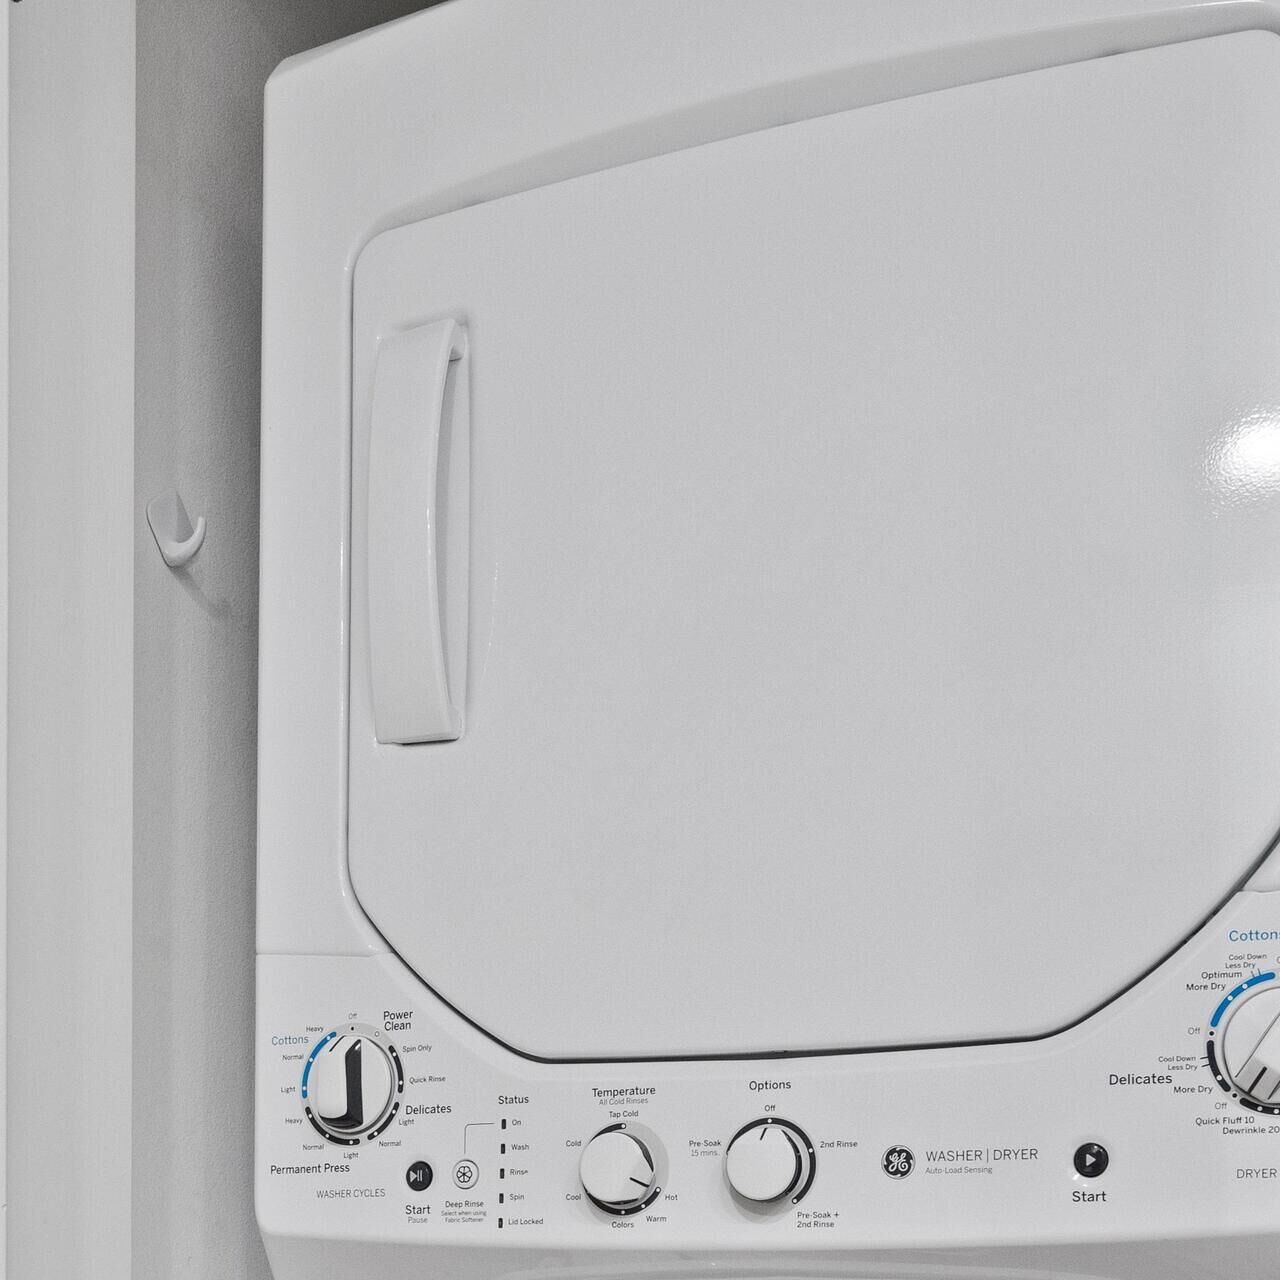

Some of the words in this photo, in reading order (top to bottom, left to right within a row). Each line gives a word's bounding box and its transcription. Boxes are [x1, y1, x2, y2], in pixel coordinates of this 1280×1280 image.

[1202, 971, 1242, 979] Optimum
[1211, 983, 1226, 991] Dry
[383, 1011, 413, 1021] Power
[384, 1021, 411, 1031] Clean
[272, 1035, 308, 1046] Cottons
[1109, 1074, 1172, 1085] Delicates
[749, 1080, 791, 1092] Options
[1198, 1086, 1212, 1094] Dry
[592, 1086, 656, 1098] Temperature
[498, 1096, 529, 1104] Status
[405, 1105, 452, 1114] Delicates
[399, 1118, 414, 1126] Light
[343, 1152, 358, 1160] Light
[926, 1150, 982, 1162] WASHER
[993, 1149, 1038, 1160] DRYER
[270, 1164, 320, 1174] Permanent
[324, 1163, 350, 1172] Press
[964, 1166, 993, 1174] Sensing
[1236, 1169, 1277, 1179] DRYER
[317, 1190, 351, 1198] WASHER
[354, 1189, 385, 1197] CYCLES
[1072, 1191, 1107, 1202] Start
[445, 1200, 462, 1209] Deep
[464, 1200, 484, 1208] Rinse
[405, 1205, 431, 1215] Start
